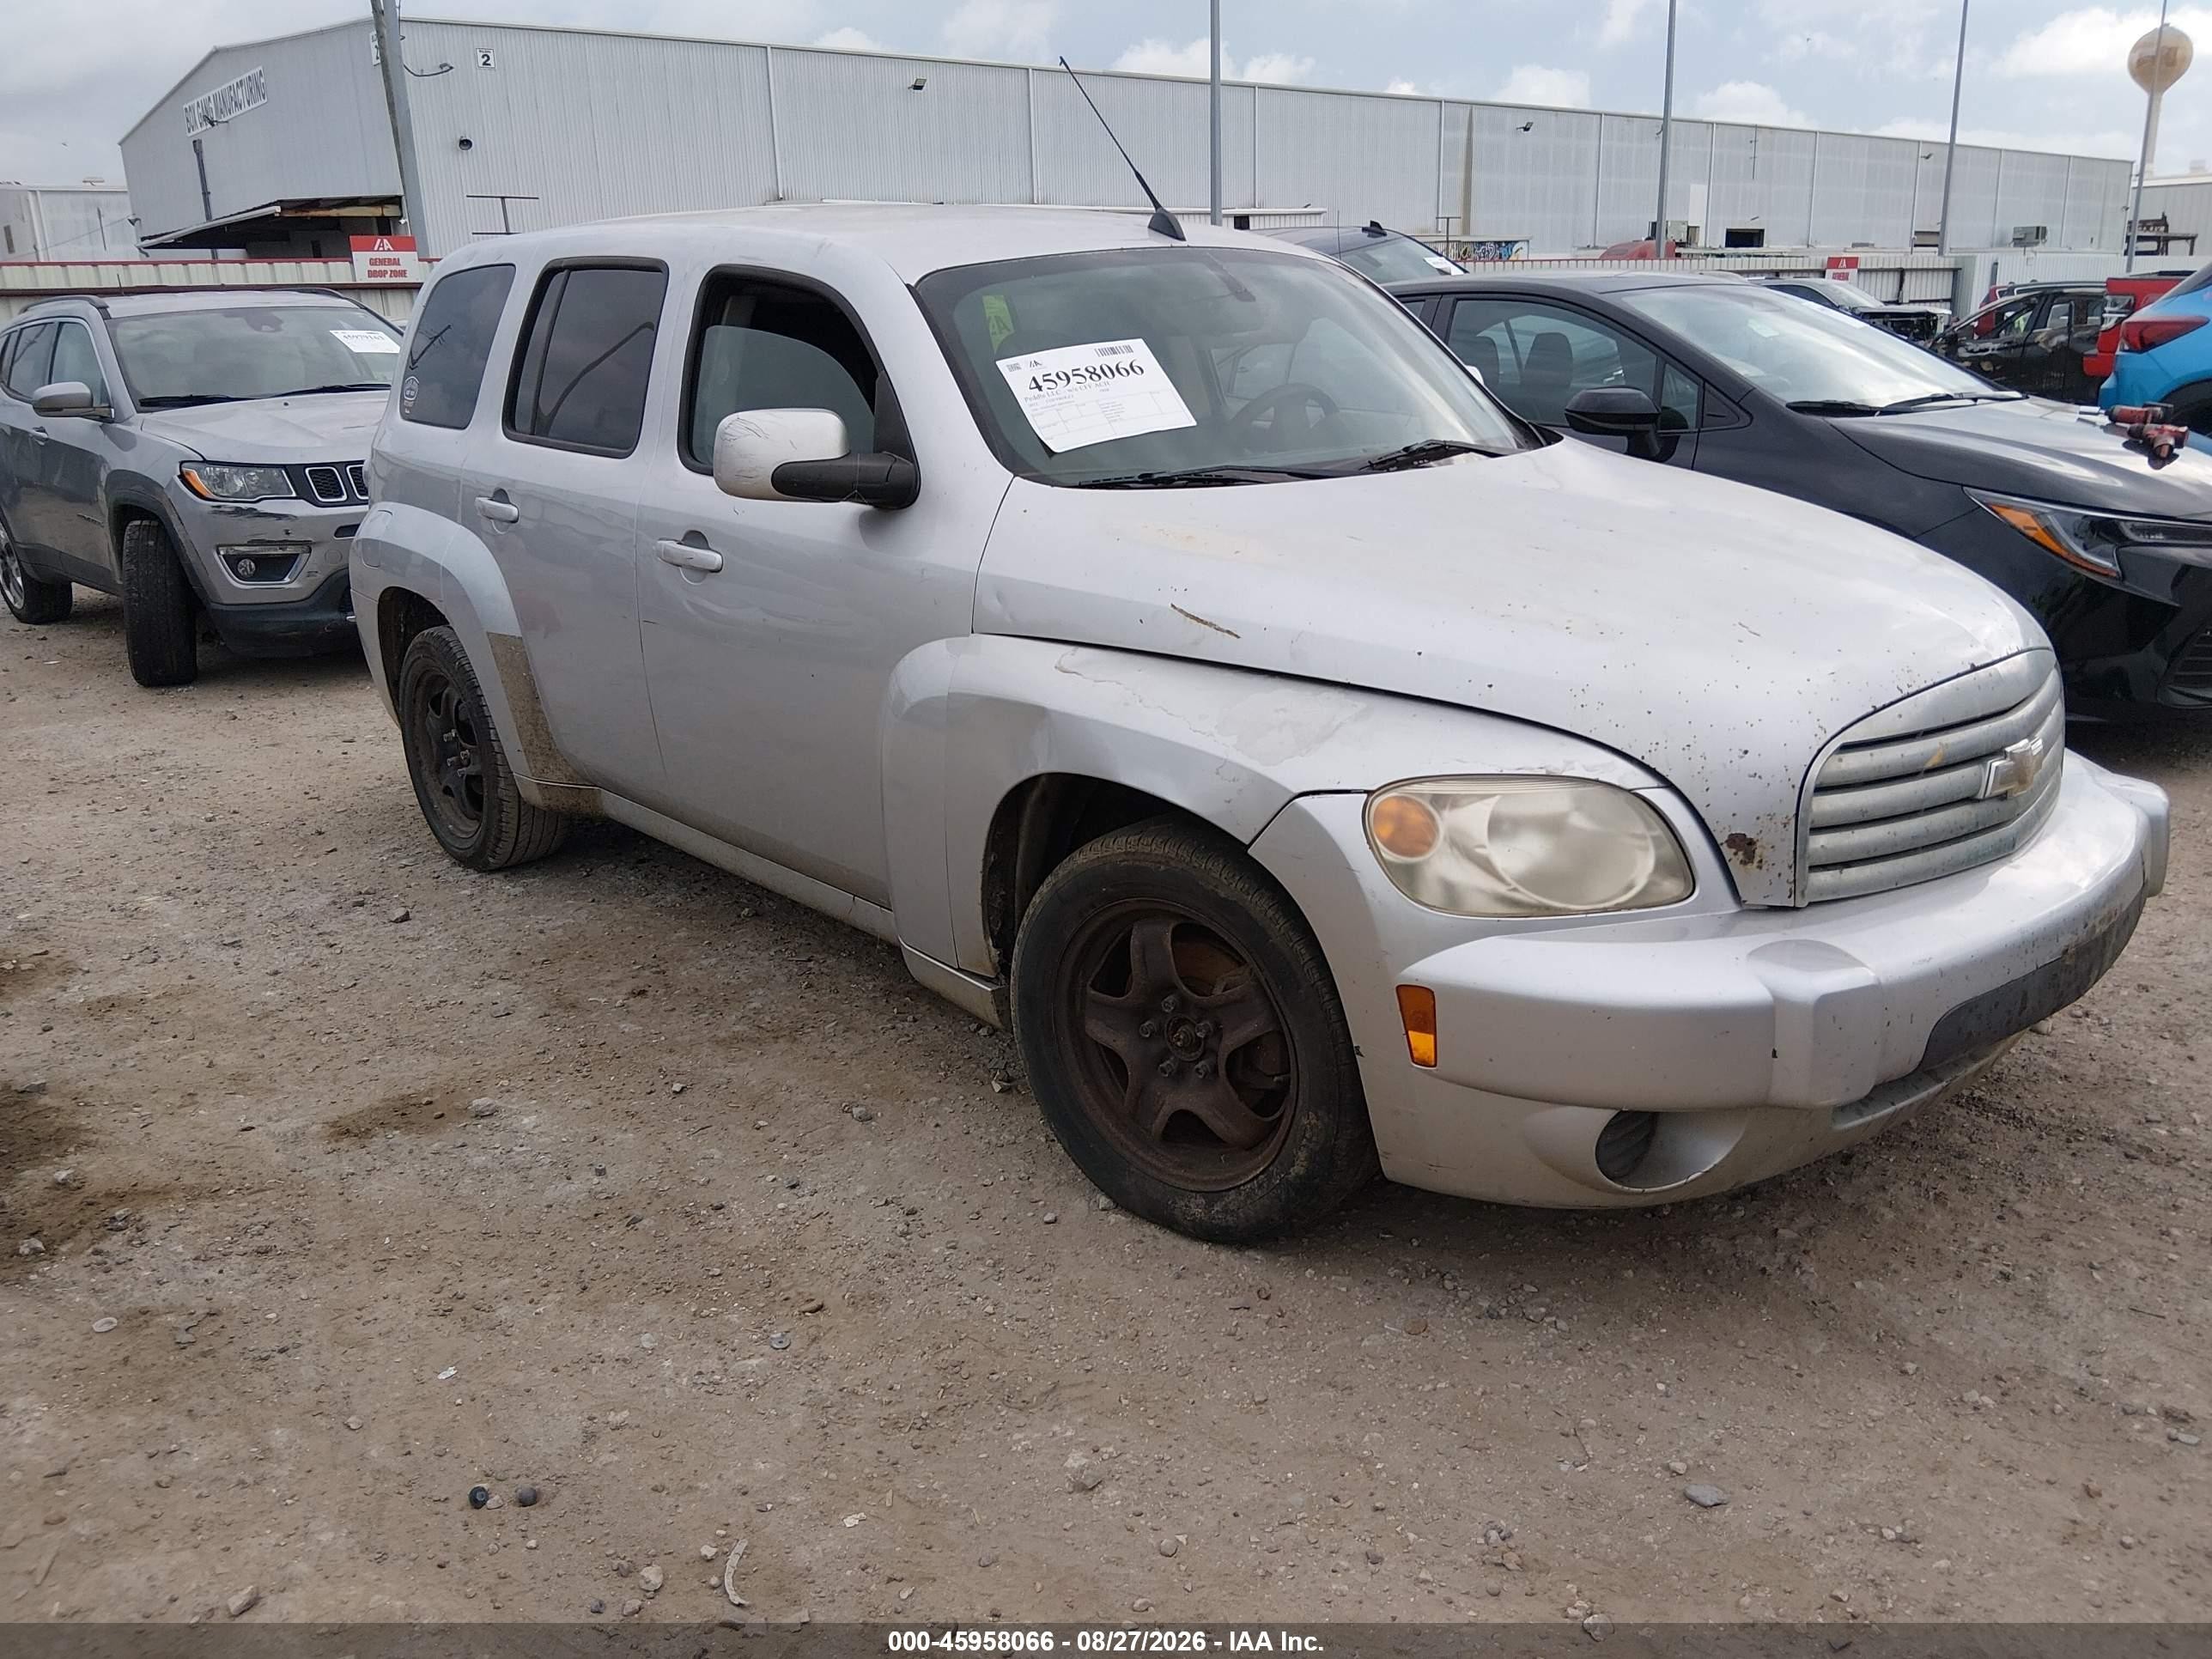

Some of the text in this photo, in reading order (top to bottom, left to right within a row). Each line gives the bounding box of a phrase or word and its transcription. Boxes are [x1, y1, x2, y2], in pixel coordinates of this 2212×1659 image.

[481, 53, 491, 66] 2
[185, 102, 201, 133] BOX
[212, 69, 266, 120] MANUFACTURING
[369, 258, 401, 266] GENERAL
[368, 269, 408, 278] DROP ZONE
[1028, 358, 1145, 392] 45958066
